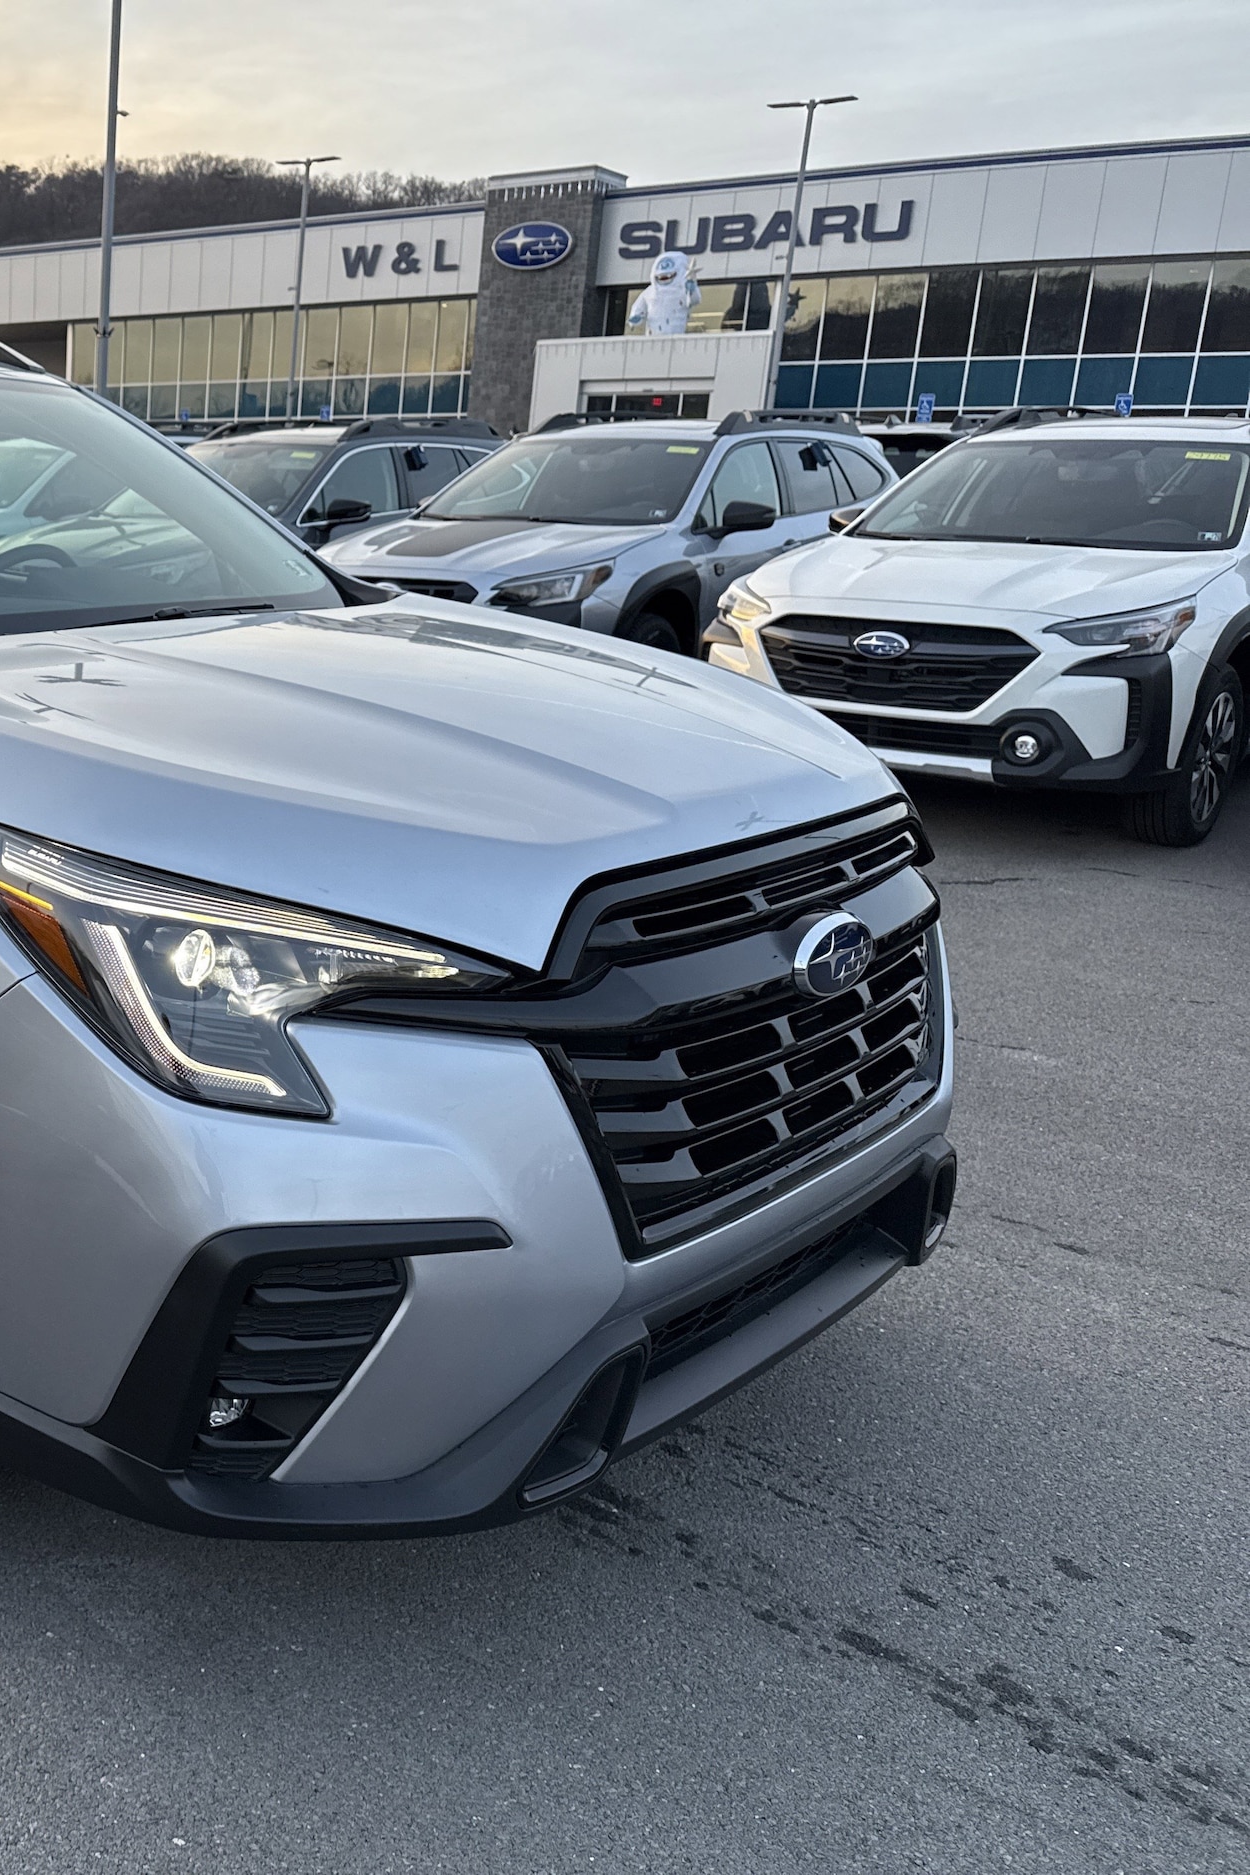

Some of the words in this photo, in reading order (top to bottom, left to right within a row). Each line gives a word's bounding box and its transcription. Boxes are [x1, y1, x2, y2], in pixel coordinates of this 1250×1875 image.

[618, 200, 915, 259] SUBARU
[342, 244, 383, 279] W
[391, 241, 421, 275] &
[434, 239, 460, 272] L
